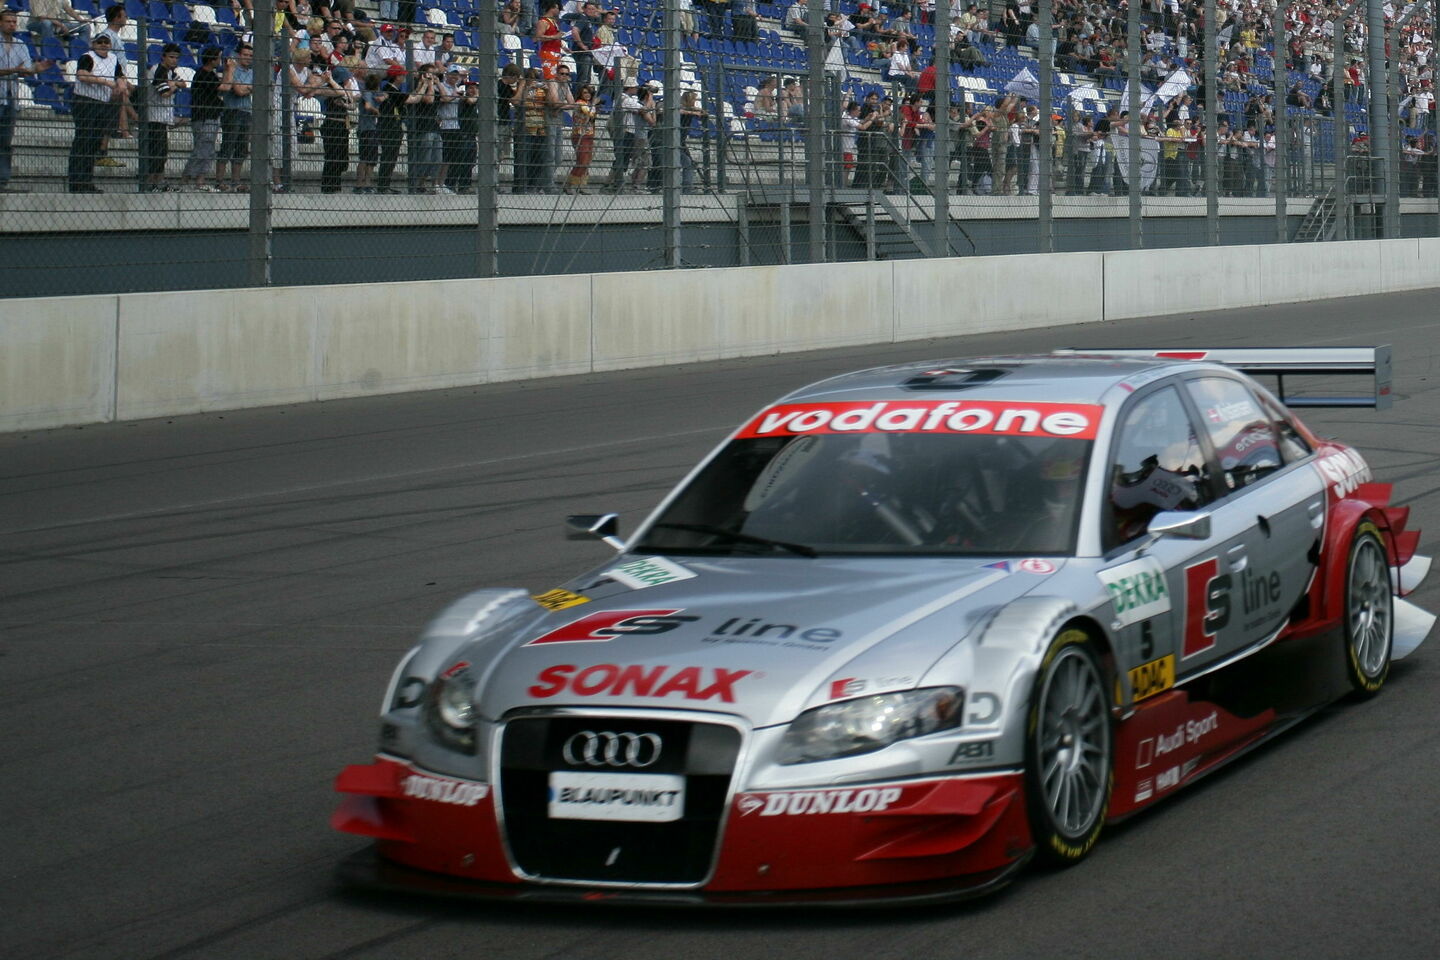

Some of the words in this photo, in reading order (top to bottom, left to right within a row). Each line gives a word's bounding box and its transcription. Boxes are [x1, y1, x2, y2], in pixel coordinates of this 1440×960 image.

[756, 401, 1090, 435] vodafone
[1106, 568, 1168, 614] DEKRA
[1242, 568, 1282, 615] line
[711, 617, 844, 643] line
[1141, 620, 1153, 661] 5
[527, 662, 756, 704] SONAX
[1131, 659, 1167, 697] ADAC
[1154, 725, 1185, 758] Audi
[1185, 710, 1219, 744] Sport
[558, 786, 680, 806] BLAUPUNKT
[760, 788, 904, 817] DUNLOP
